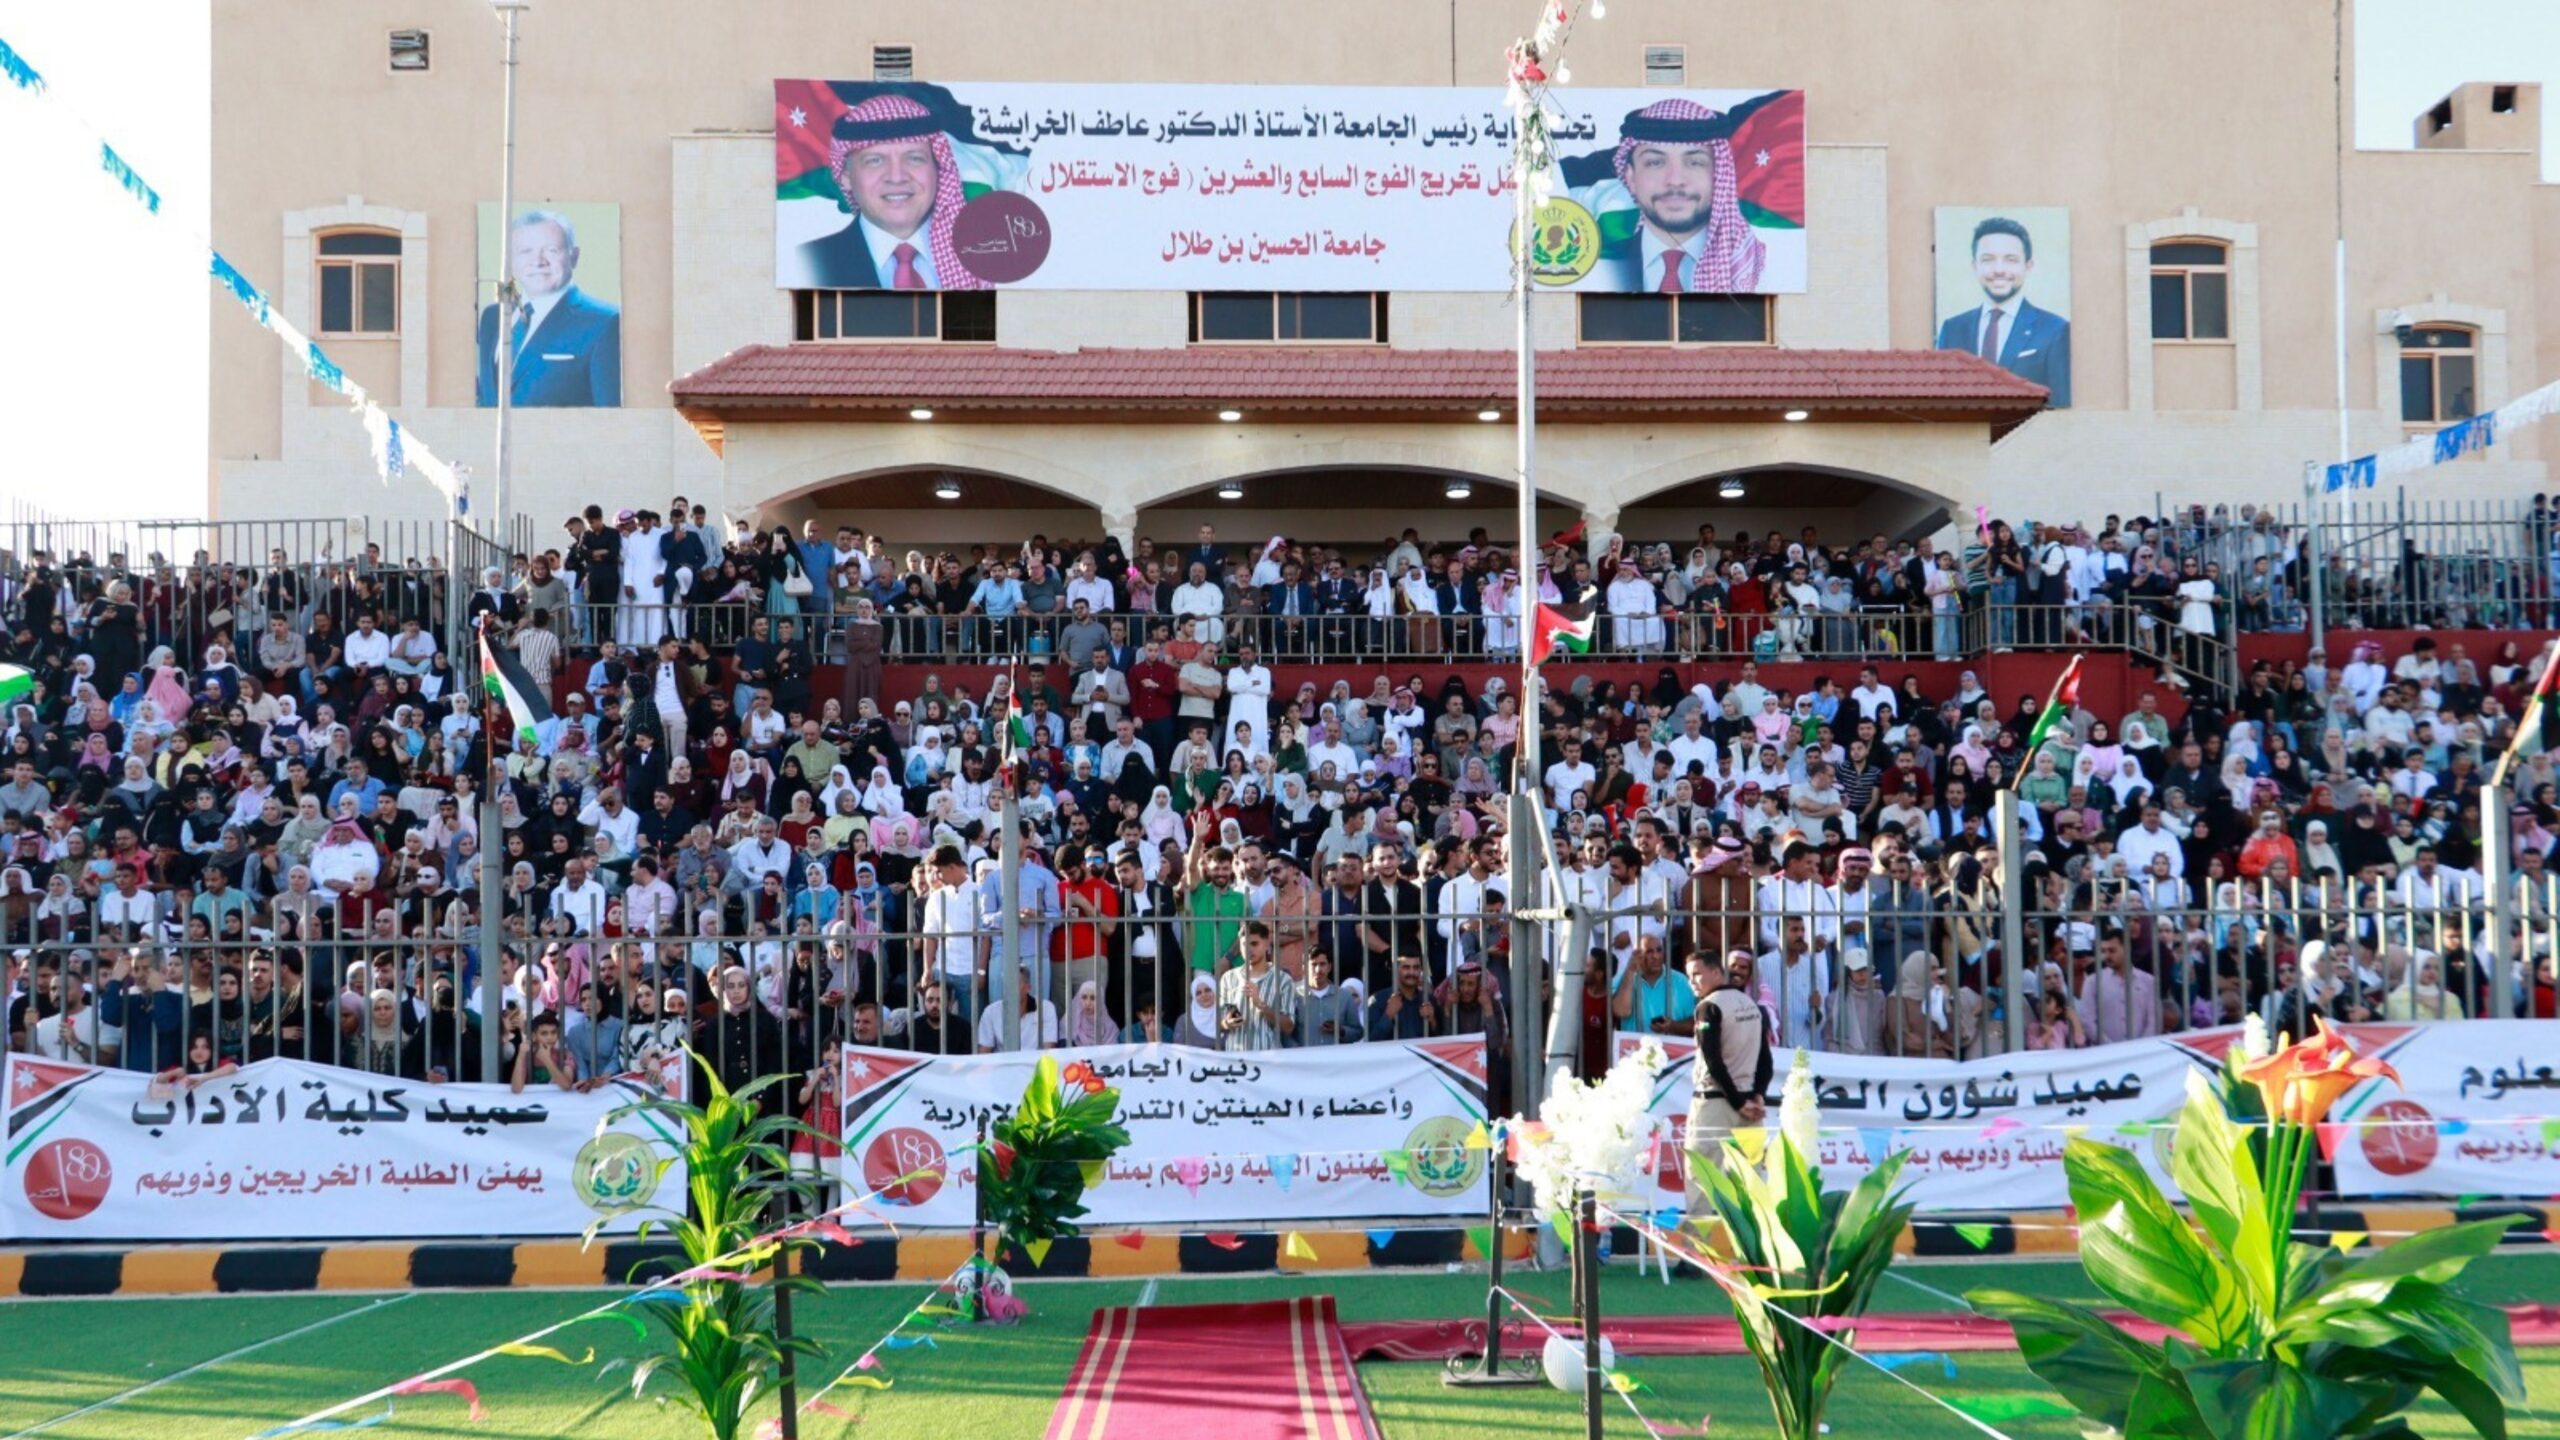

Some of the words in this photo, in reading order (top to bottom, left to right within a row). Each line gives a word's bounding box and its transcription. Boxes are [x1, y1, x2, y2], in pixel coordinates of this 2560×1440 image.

[978, 105, 1076, 144] الخرابشة
[1081, 109, 1150, 137] عاطف
[1153, 111, 1247, 143] الدكتور
[1254, 105, 1328, 138] الأستاذ
[1333, 112, 1416, 146] الجامعة
[1421, 113, 1478, 147] رئيس
[1484, 113, 1518, 148] اية
[1041, 160, 1137, 193] الاستقلال
[1142, 161, 1181, 195] فوج
[1199, 158, 1293, 195] والعشرين
[1299, 162, 1358, 198] السابع
[1364, 162, 1415, 196] الفوج
[1420, 163, 1481, 198] تخريج
[1487, 164, 1518, 197] فل
[1161, 230, 1214, 262] طلال
[1218, 234, 1244, 264] بن
[1248, 231, 1318, 264] الحسين
[1323, 230, 1387, 264] جامعة
[1189, 1058, 1262, 1084] رئيس
[131, 1081, 287, 1139] الآداب
[301, 1078, 410, 1137] كلية
[1312, 1088, 1414, 1121] وأعضاء
[1903, 1070, 2019, 1122] شؤون
[2033, 1070, 2143, 1117] عميد
[425, 1097, 550, 1136] عميد
[1108, 1097, 1185, 1127] التدر
[1192, 1097, 1304, 1127] الهيئتين
[1104, 1153, 1152, 1188] بمنا
[1240, 1151, 1310, 1184] البة
[1938, 1138, 2011, 1172] وذويهم
[136, 1161, 233, 1198] وذويهم
[239, 1161, 372, 1196] الخريجين
[378, 1158, 470, 1194] الطلبة
[476, 1159, 546, 1194] يهنئ
